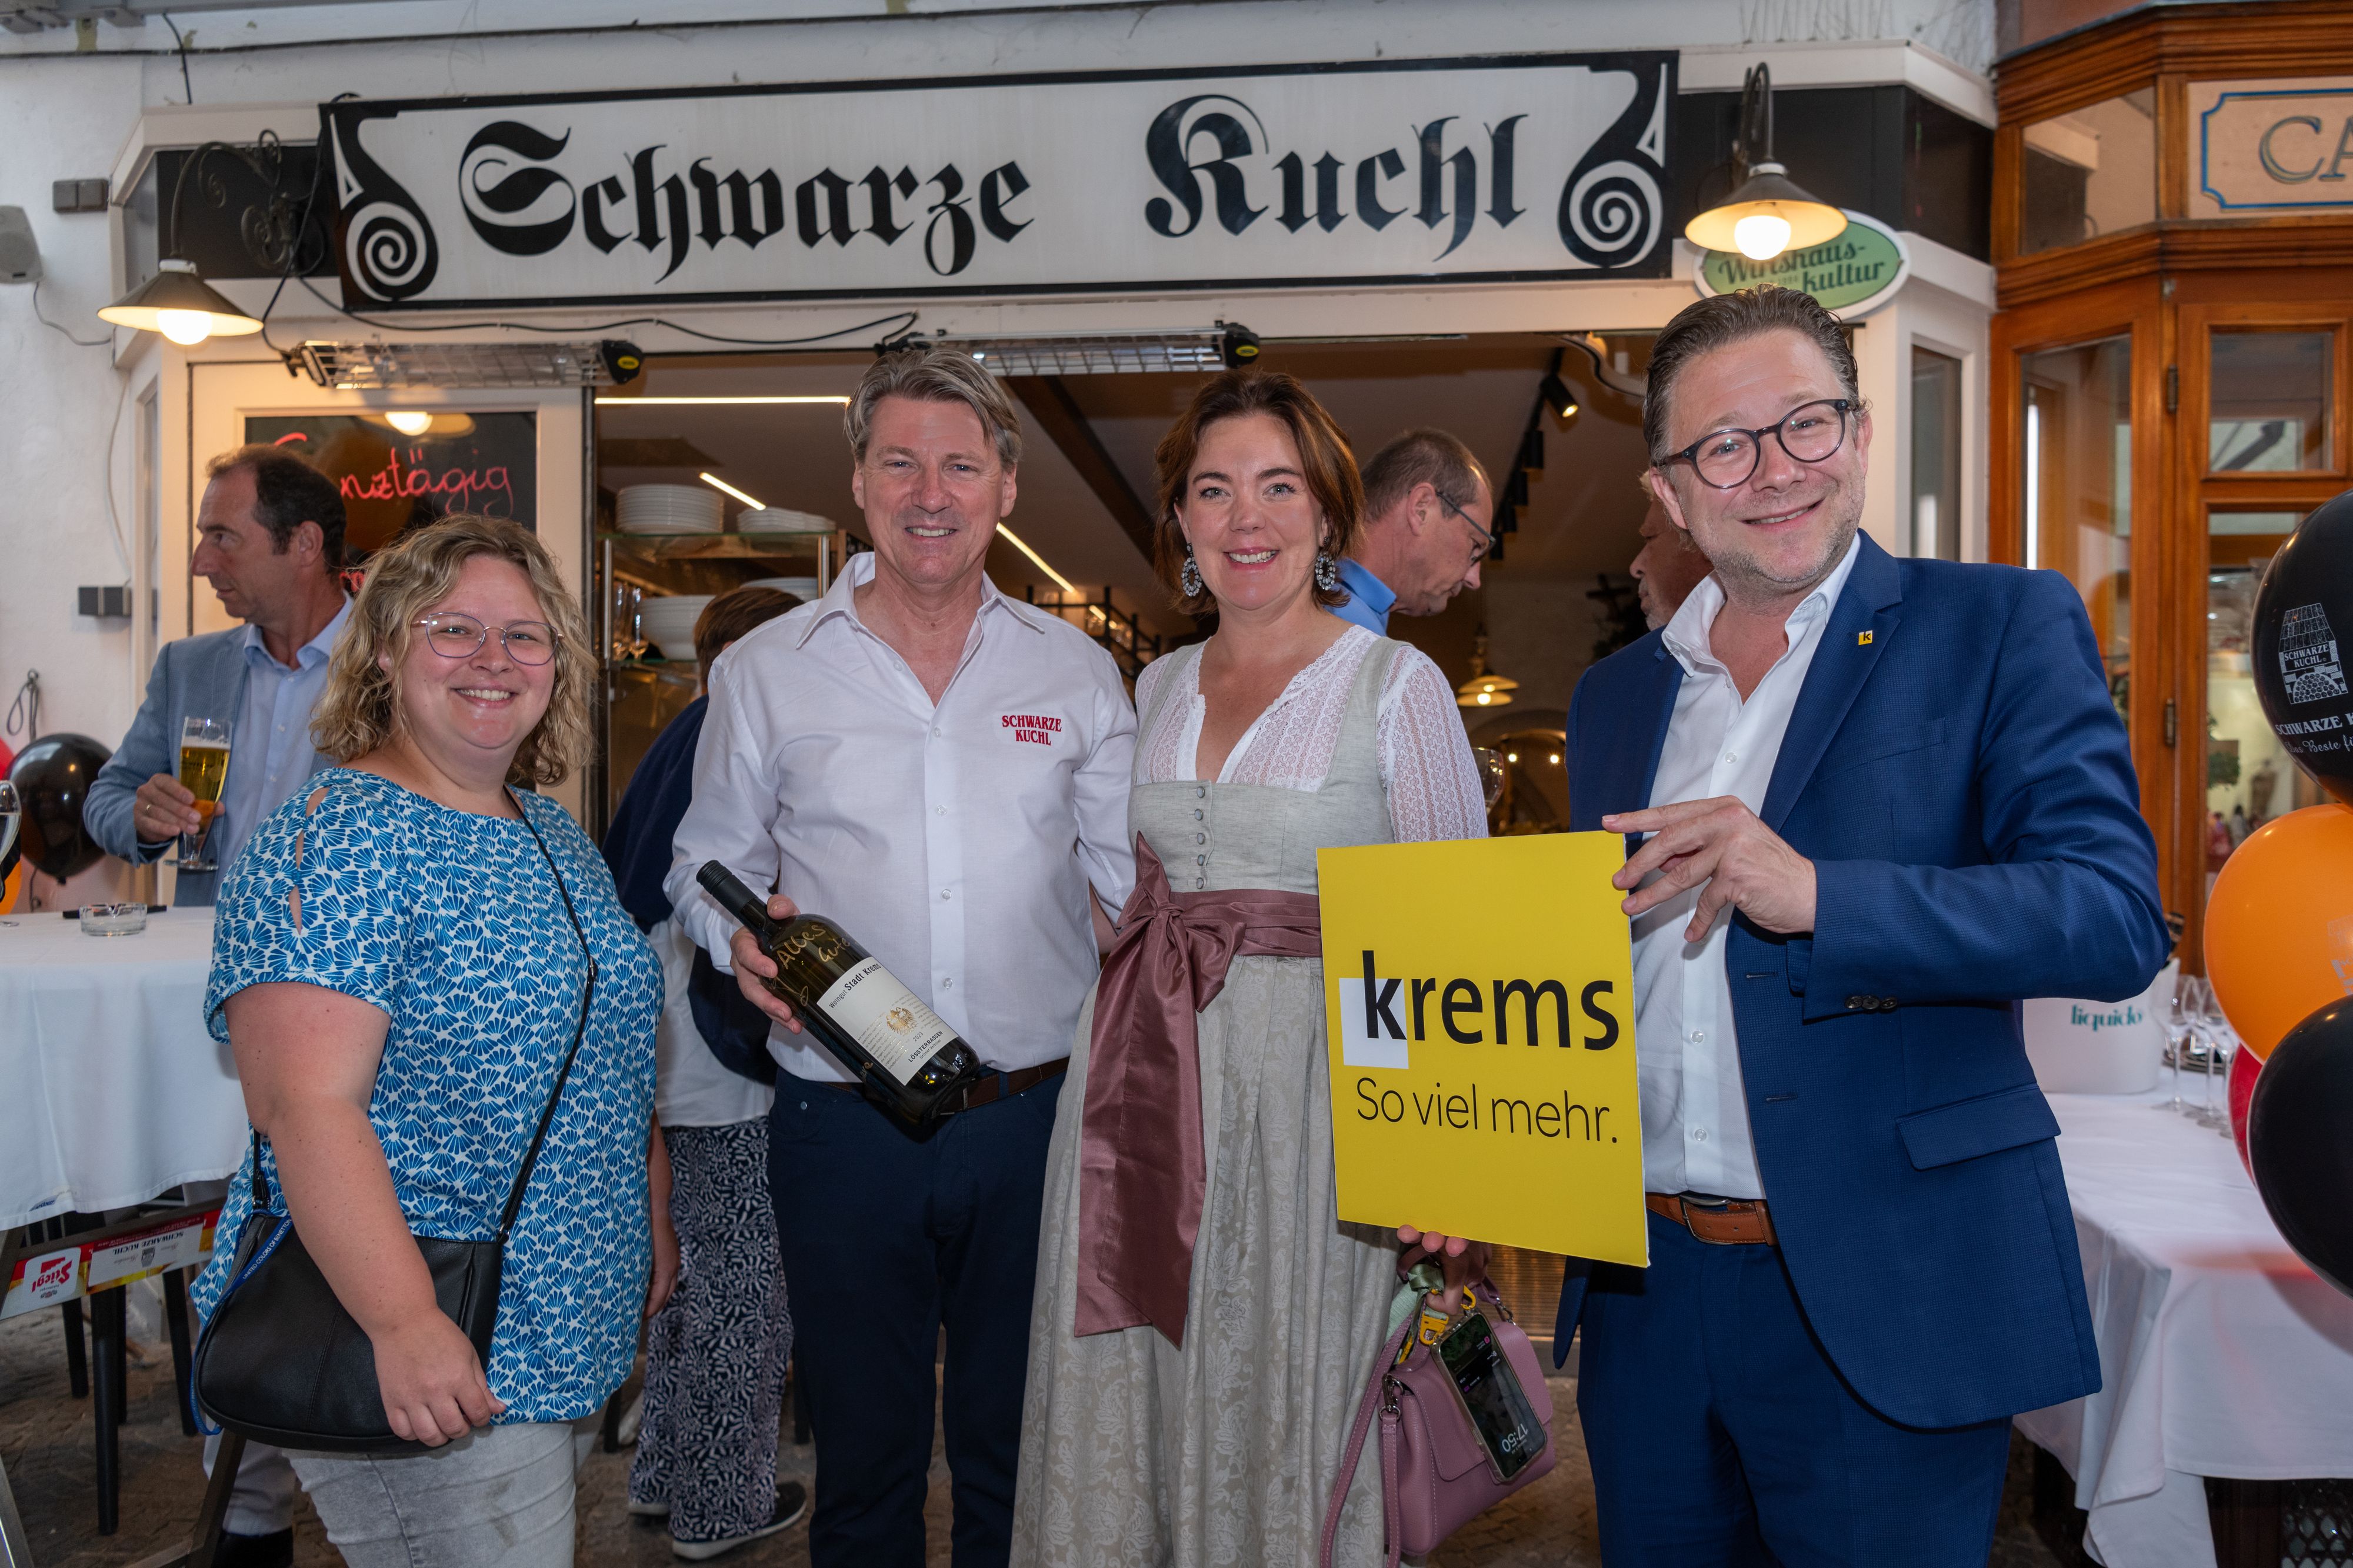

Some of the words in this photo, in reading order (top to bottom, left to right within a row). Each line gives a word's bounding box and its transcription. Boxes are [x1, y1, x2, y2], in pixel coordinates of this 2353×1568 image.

[458, 121, 1035, 285] Schwarze
[1144, 94, 1529, 263] Kuchl
[1802, 262, 1885, 293] kultur
[2284, 644, 2329, 661] SCHWARZE
[2294, 655, 2322, 668] KUCHL
[1002, 715, 1062, 732] SCHWARZE
[1015, 729, 1052, 746] KUCHL
[2275, 716, 2342, 735] SCHWARZE
[2302, 739, 2341, 753] Beste
[829, 990, 848, 1009] Weingut
[844, 972, 864, 990] Stadt
[862, 962, 881, 976] Krems
[1362, 950, 1619, 1051] krems
[2071, 1004, 2143, 1032] liquido
[908, 1030, 943, 1062] LÖSSTERRASSEN
[912, 1032, 924, 1042] 2023
[1357, 1077, 1405, 1123] So
[1412, 1082, 1478, 1130] viel
[1491, 1089, 1618, 1144] mehr.
[113, 1242, 139, 1255] KUCHL
[142, 1231, 184, 1248] SCHWARZE
[31, 1260, 72, 1293] Stiegl
[243, 1263, 258, 1279] UNITED
[256, 1246, 272, 1264] COLORS
[1502, 1423, 1528, 1452] 17:50
